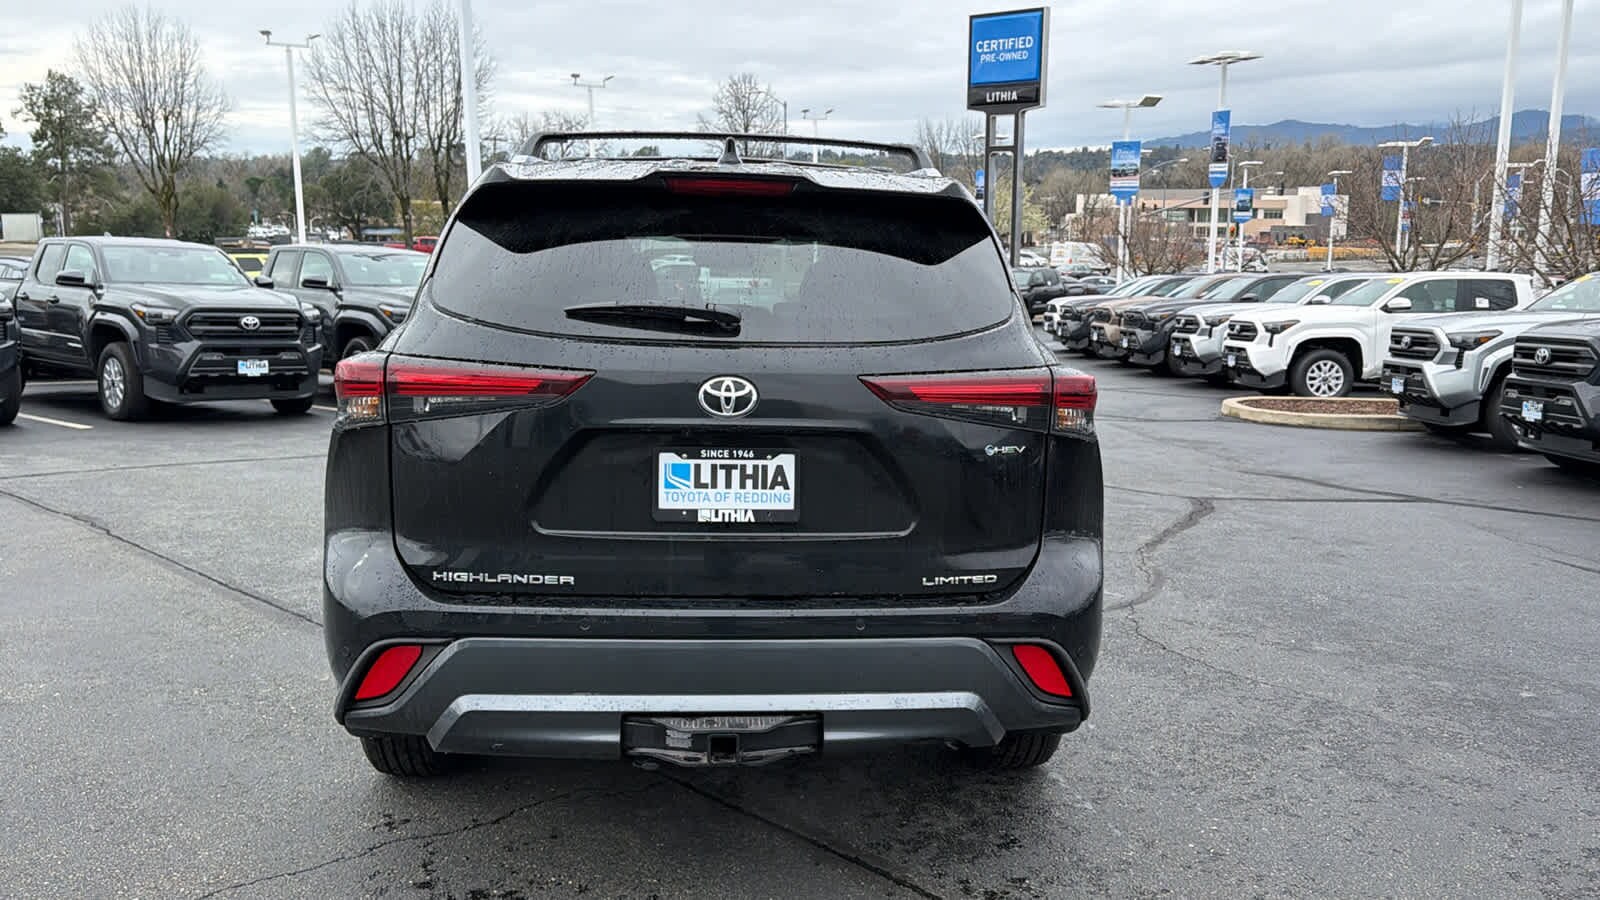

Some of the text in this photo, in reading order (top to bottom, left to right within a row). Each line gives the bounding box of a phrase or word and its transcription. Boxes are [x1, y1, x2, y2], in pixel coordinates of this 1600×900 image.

[976, 36, 1033, 52] CERTIFIED
[980, 51, 1029, 63] PRE-OWNED
[986, 91, 1018, 102] LITHIA
[700, 449, 754, 458] SINCE 1946
[693, 463, 789, 490] LITHIA
[664, 491, 791, 504] TOYOTA OF REDDING
[711, 510, 755, 522] LITHIA
[432, 571, 575, 585] HIGHLANDER
[922, 575, 998, 586] LIMITED
